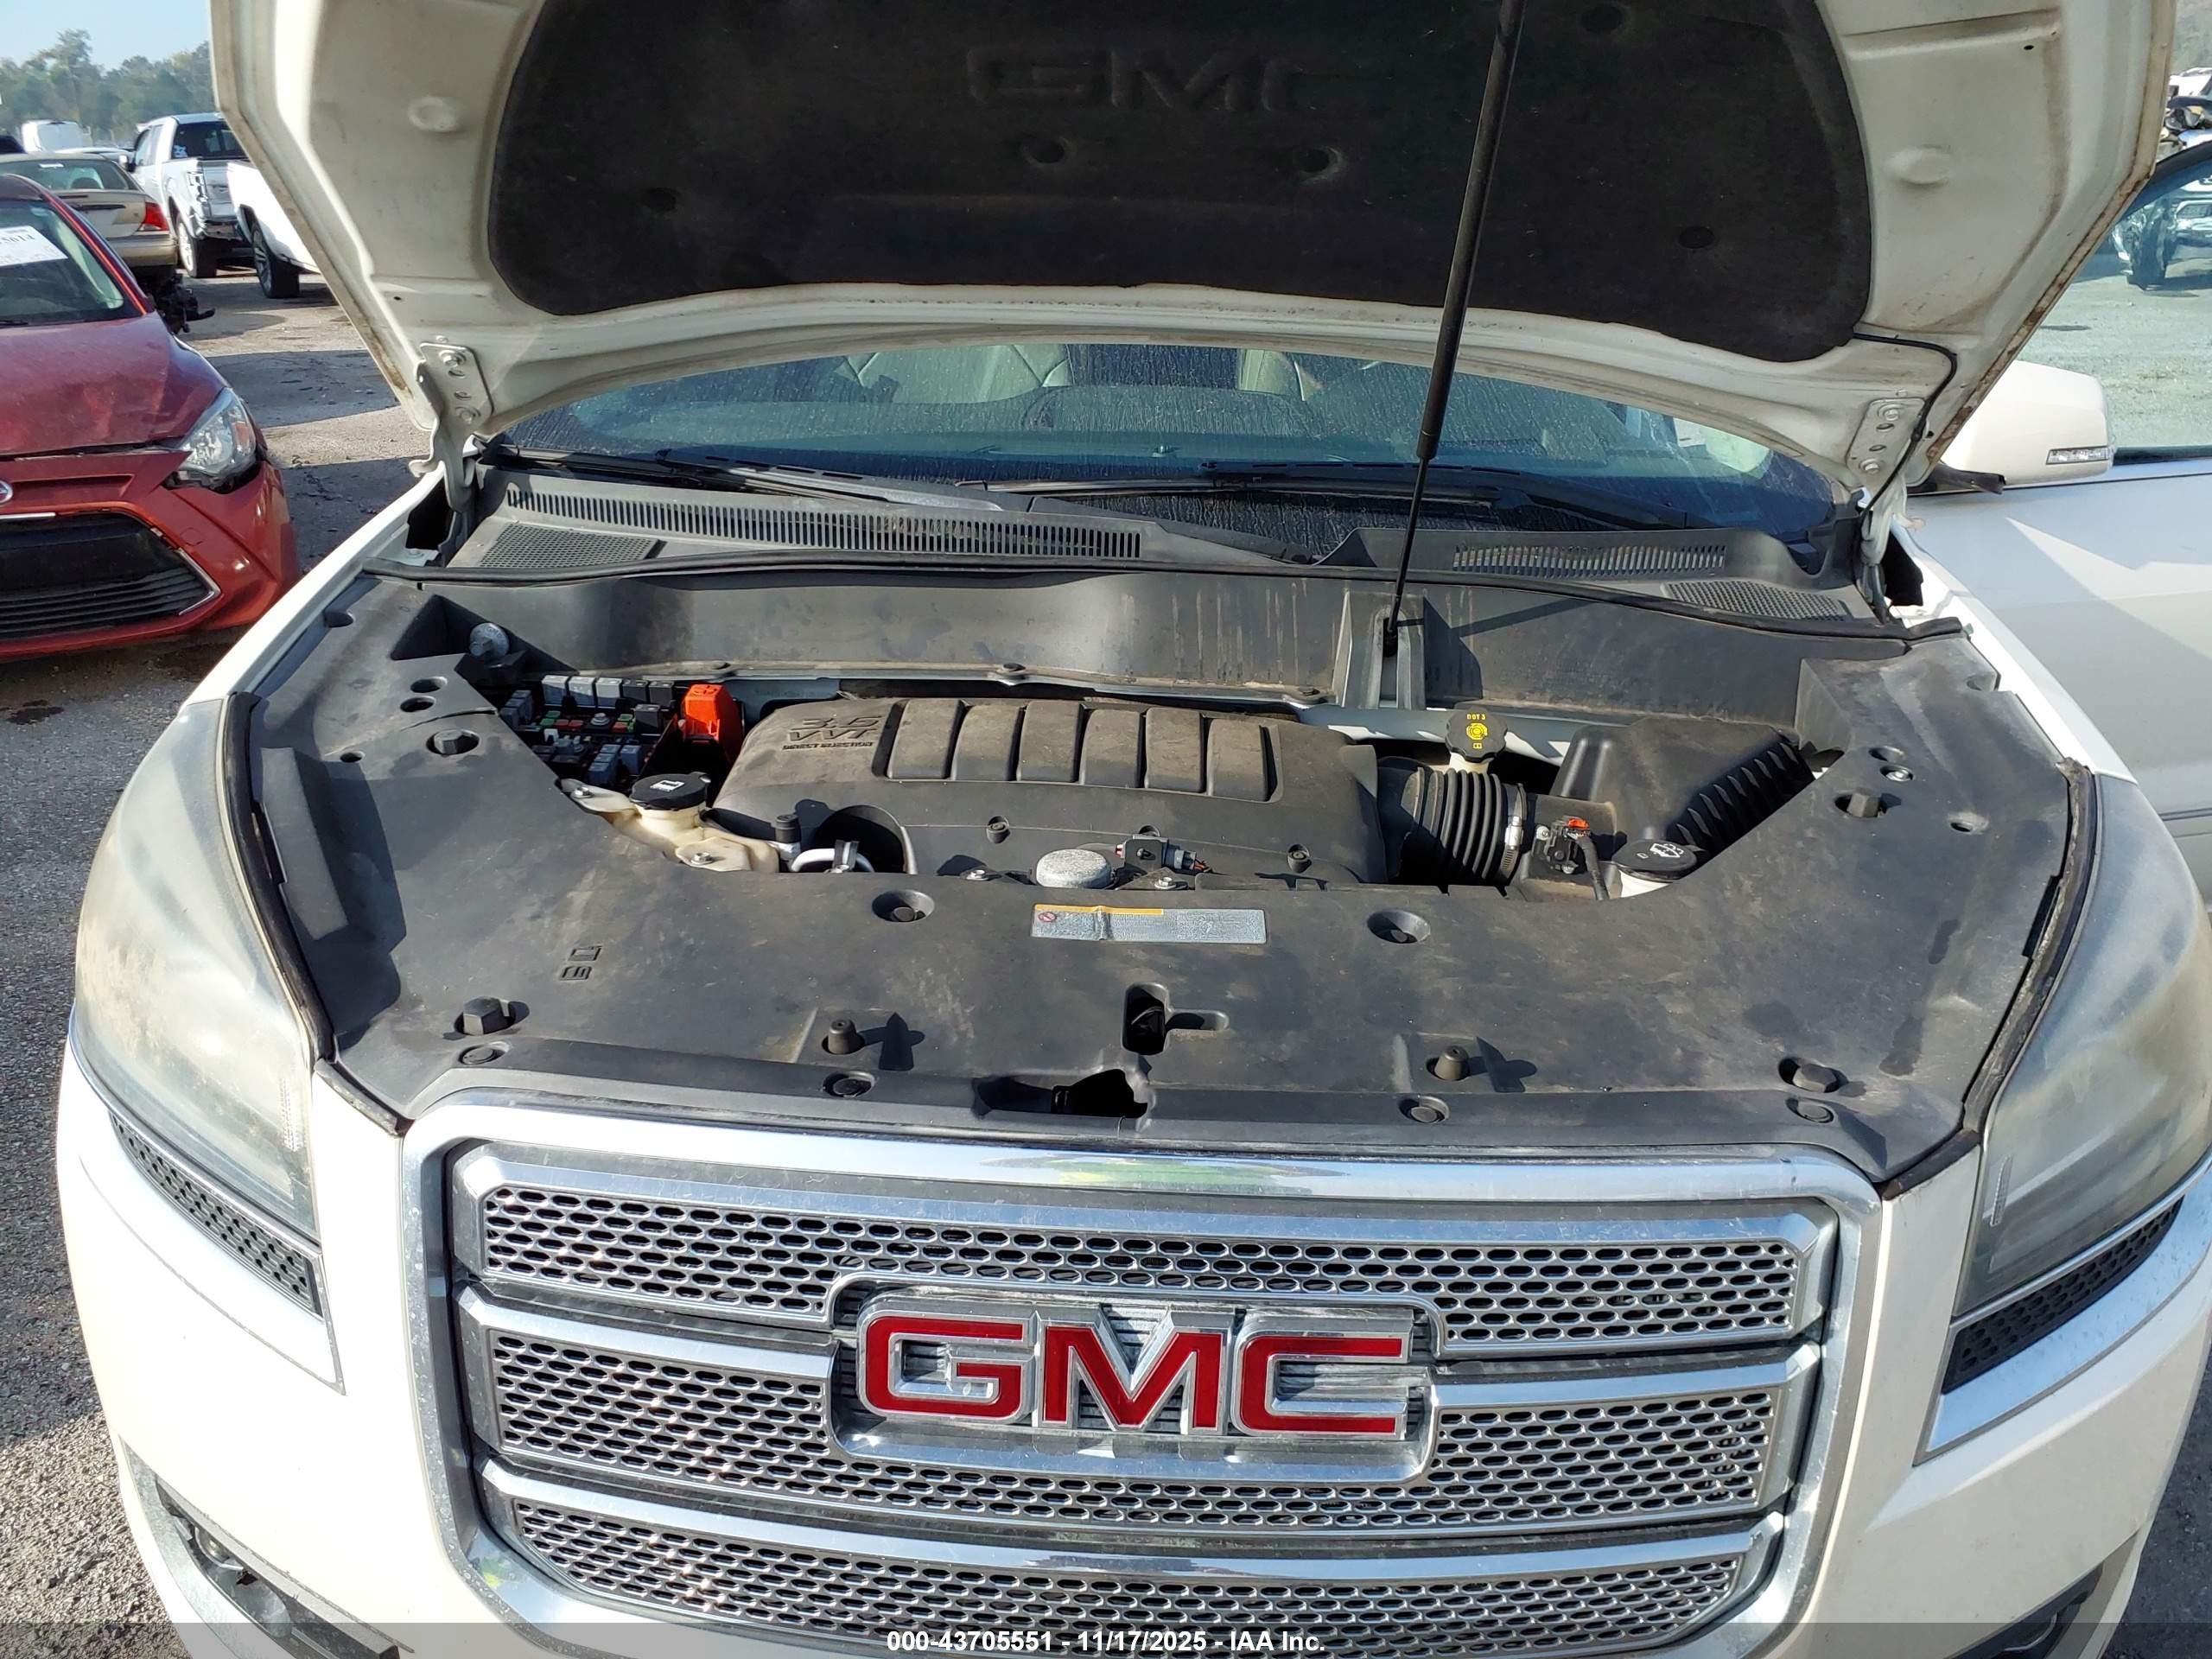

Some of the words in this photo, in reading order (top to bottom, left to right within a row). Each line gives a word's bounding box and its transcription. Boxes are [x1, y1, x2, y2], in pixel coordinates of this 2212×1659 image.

[791, 715, 882, 730] 3.6
[788, 728, 878, 741] VVT
[860, 1308, 1410, 1435] GMC
